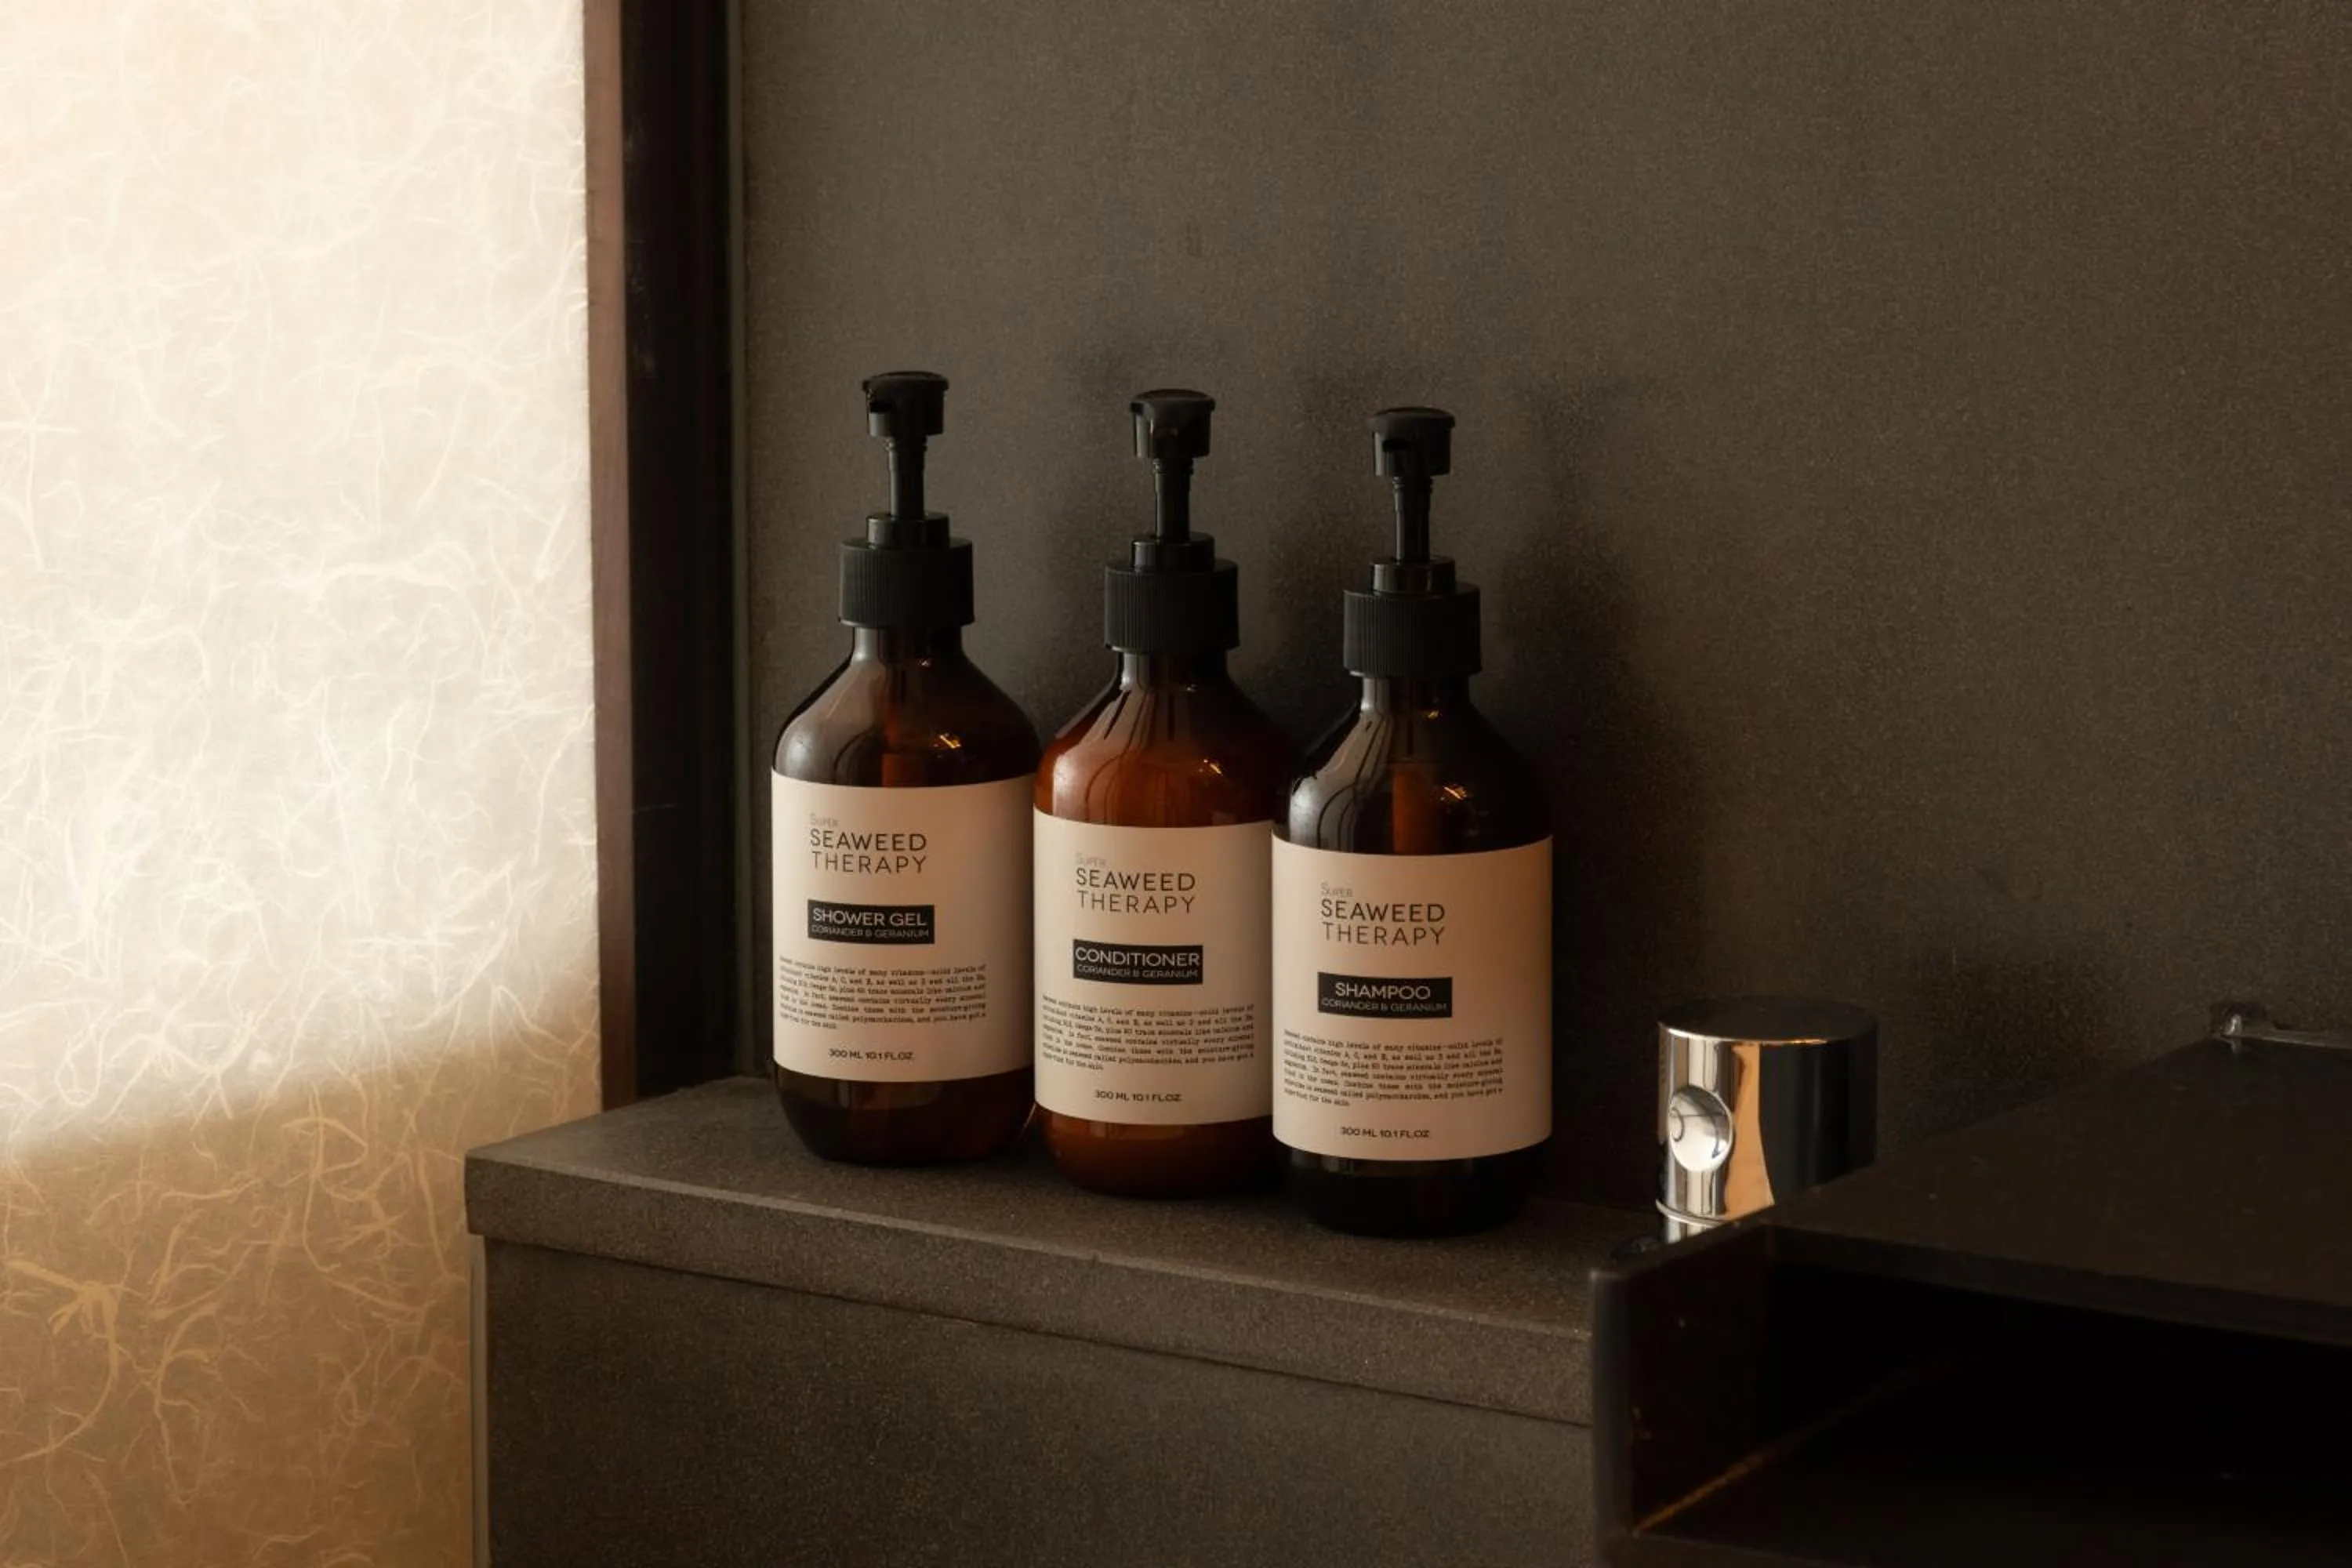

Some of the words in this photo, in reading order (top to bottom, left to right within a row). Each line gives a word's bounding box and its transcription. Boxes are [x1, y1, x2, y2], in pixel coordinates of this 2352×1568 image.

[810, 828, 927, 851] SEAWEED
[811, 851, 927, 874] THERAPY
[1076, 867, 1196, 891] SEAWEED
[1078, 890, 1195, 914] THERAPY
[1321, 898, 1445, 922] SEAWEED
[812, 907, 885, 926] SHOWER
[889, 912, 927, 927] GEL
[811, 924, 863, 937] CORIANDER
[875, 928, 929, 938] GERANIUM
[1322, 921, 1445, 946] THERAPY
[1075, 946, 1200, 967] CONDITIONER
[1076, 964, 1131, 976] CORIANDER
[1142, 969, 1198, 978] GERANIUM
[1335, 982, 1431, 1000] SHAMPOO
[1321, 997, 1378, 1011] CORIANDER
[1391, 1002, 1446, 1013] GERANIUM
[828, 1047, 848, 1058] 300
[1363, 1129, 1377, 1138] ML
